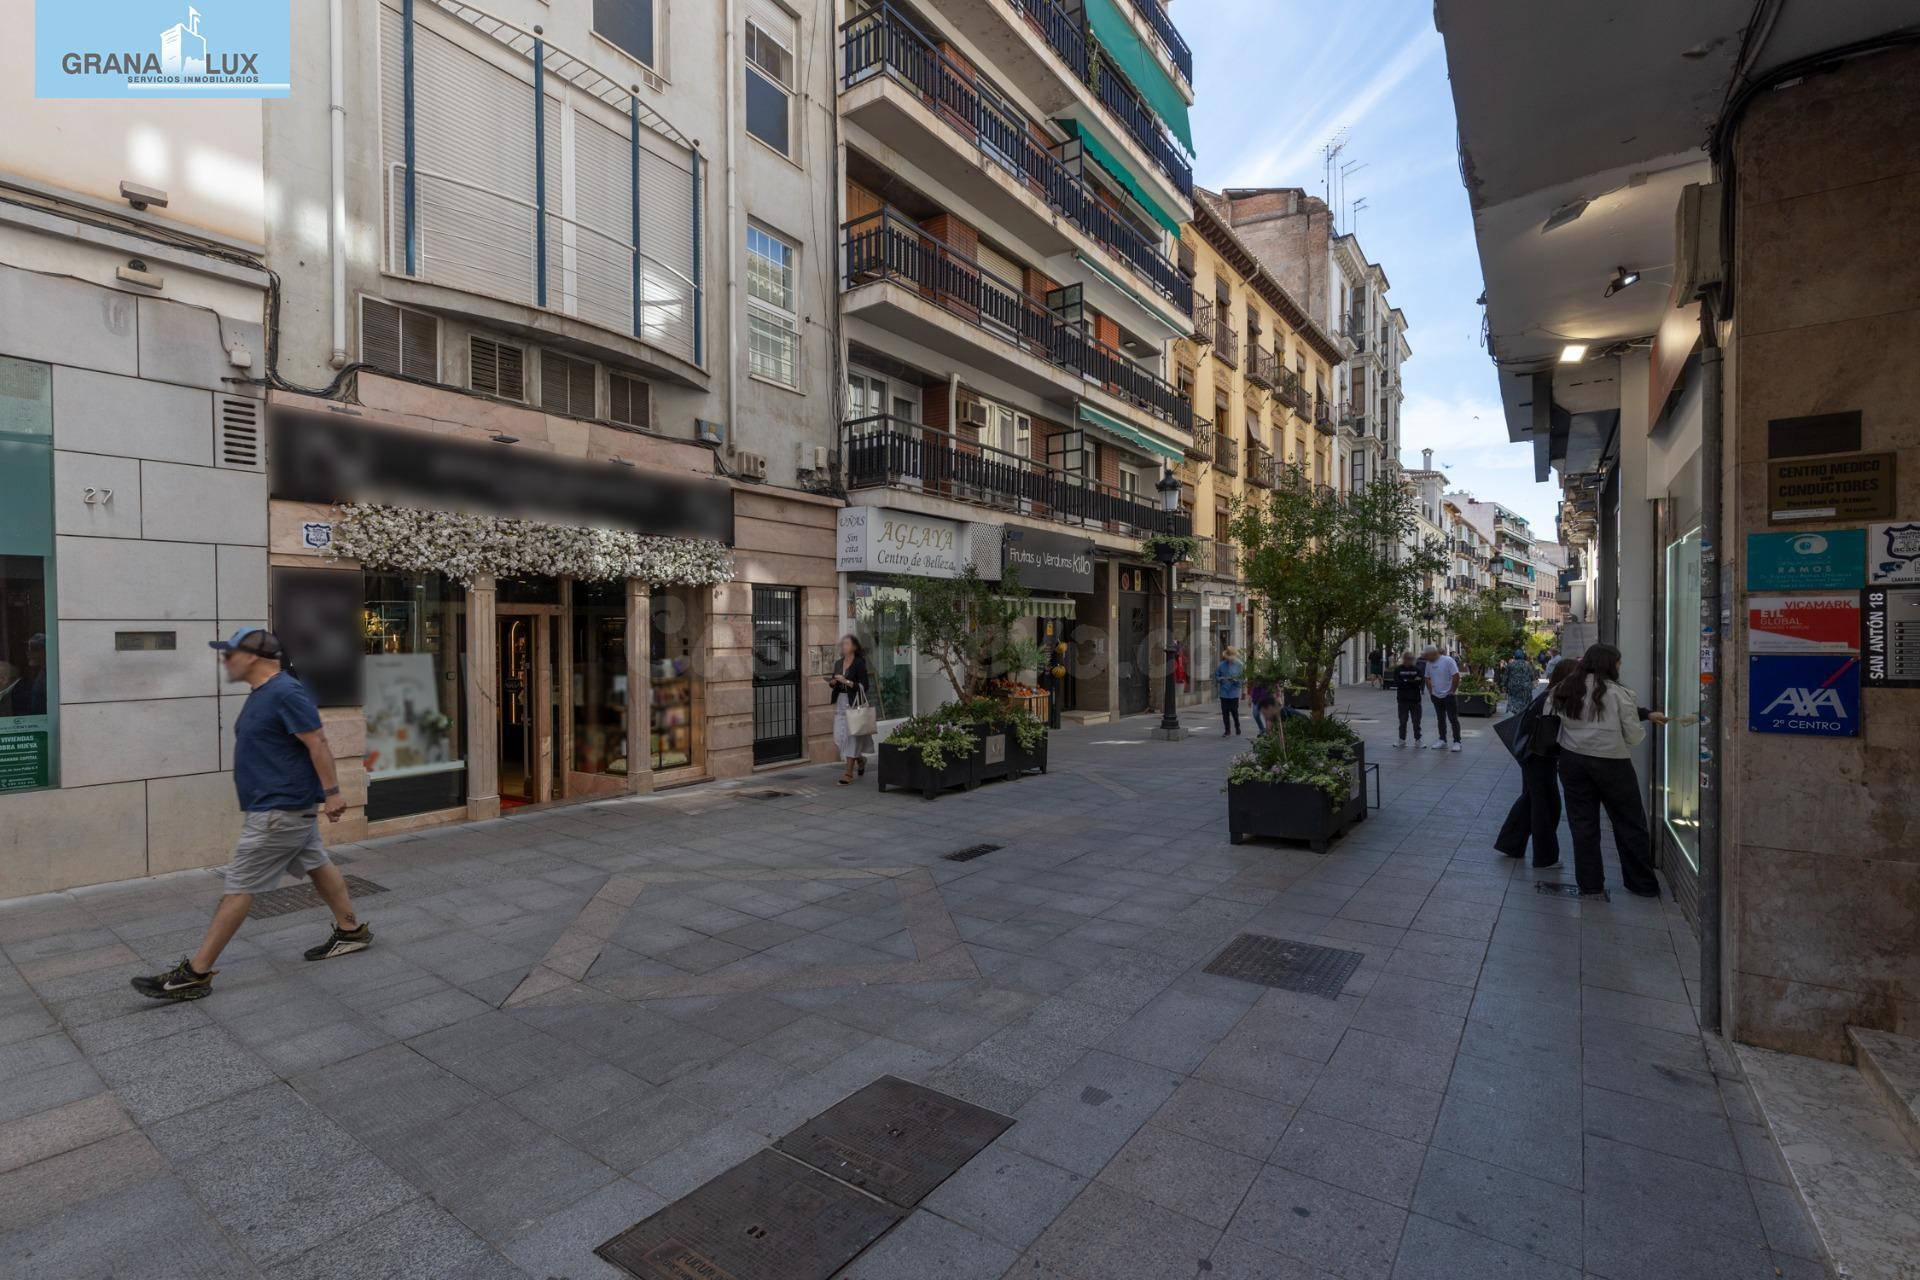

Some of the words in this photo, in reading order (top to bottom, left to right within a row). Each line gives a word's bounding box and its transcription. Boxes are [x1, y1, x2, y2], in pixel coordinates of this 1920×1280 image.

[1779, 465, 1827, 479] CENTRO
[84, 487, 114, 505] 27
[1779, 478, 1879, 497] CONDUCTORES
[877, 521, 953, 551] AGLAYA
[877, 550, 909, 565] Centro
[911, 552, 922, 567] de
[1010, 548, 1035, 564] Frutas
[1035, 554, 1041, 567] y
[1042, 551, 1072, 568] Verduras
[1072, 553, 1091, 575] Killo
[1777, 565, 1832, 574] RAMOS
[1785, 599, 1853, 609] VICAMARK
[1869, 592, 1884, 609] 18
[1760, 608, 1784, 618] ETL
[1760, 616, 1802, 625] GLOBAL
[1867, 611, 1884, 652] ANTÓN
[1869, 655, 1884, 680] SAN
[1760, 687, 1848, 718] AXA
[1788, 720, 1841, 731] CENTRO
